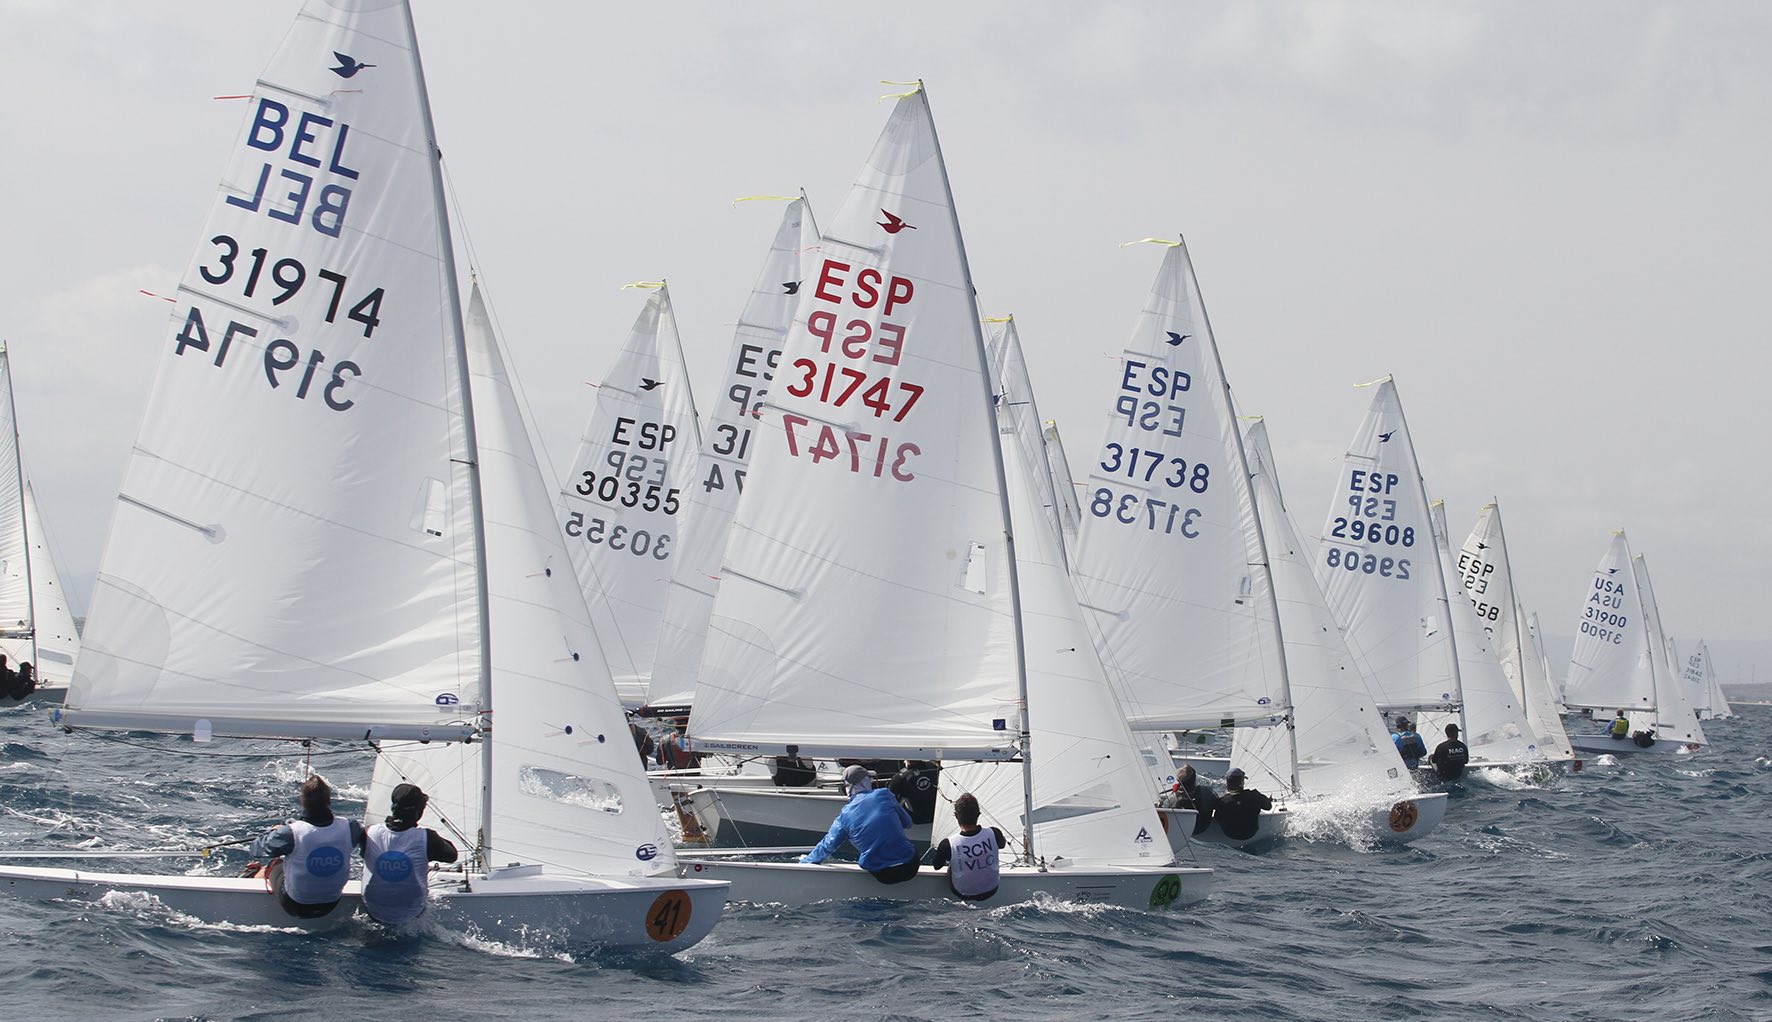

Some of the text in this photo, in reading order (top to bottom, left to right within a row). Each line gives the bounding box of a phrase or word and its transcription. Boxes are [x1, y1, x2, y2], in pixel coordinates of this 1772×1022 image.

[247, 98, 360, 180] BEL
[199, 235, 385, 339] 31974
[814, 259, 914, 316] ESP
[736, 344, 783, 381] ES
[786, 358, 925, 422] 31747
[1121, 360, 1192, 401] ESP
[612, 417, 677, 451] ESP
[713, 424, 752, 460] 31
[1100, 443, 1210, 493] 31738
[1350, 470, 1399, 495] ESP
[576, 471, 680, 515] 30355
[1331, 517, 1415, 547] 29608
[1458, 554, 1494, 577] ESP
[1594, 577, 1625, 596] USA
[1471, 598, 1499, 621] 58
[1585, 606, 1627, 628] 31900
[310, 855, 342, 868] mas
[378, 858, 409, 873] mas
[962, 838, 993, 858] RCN
[654, 899, 682, 936] 41
